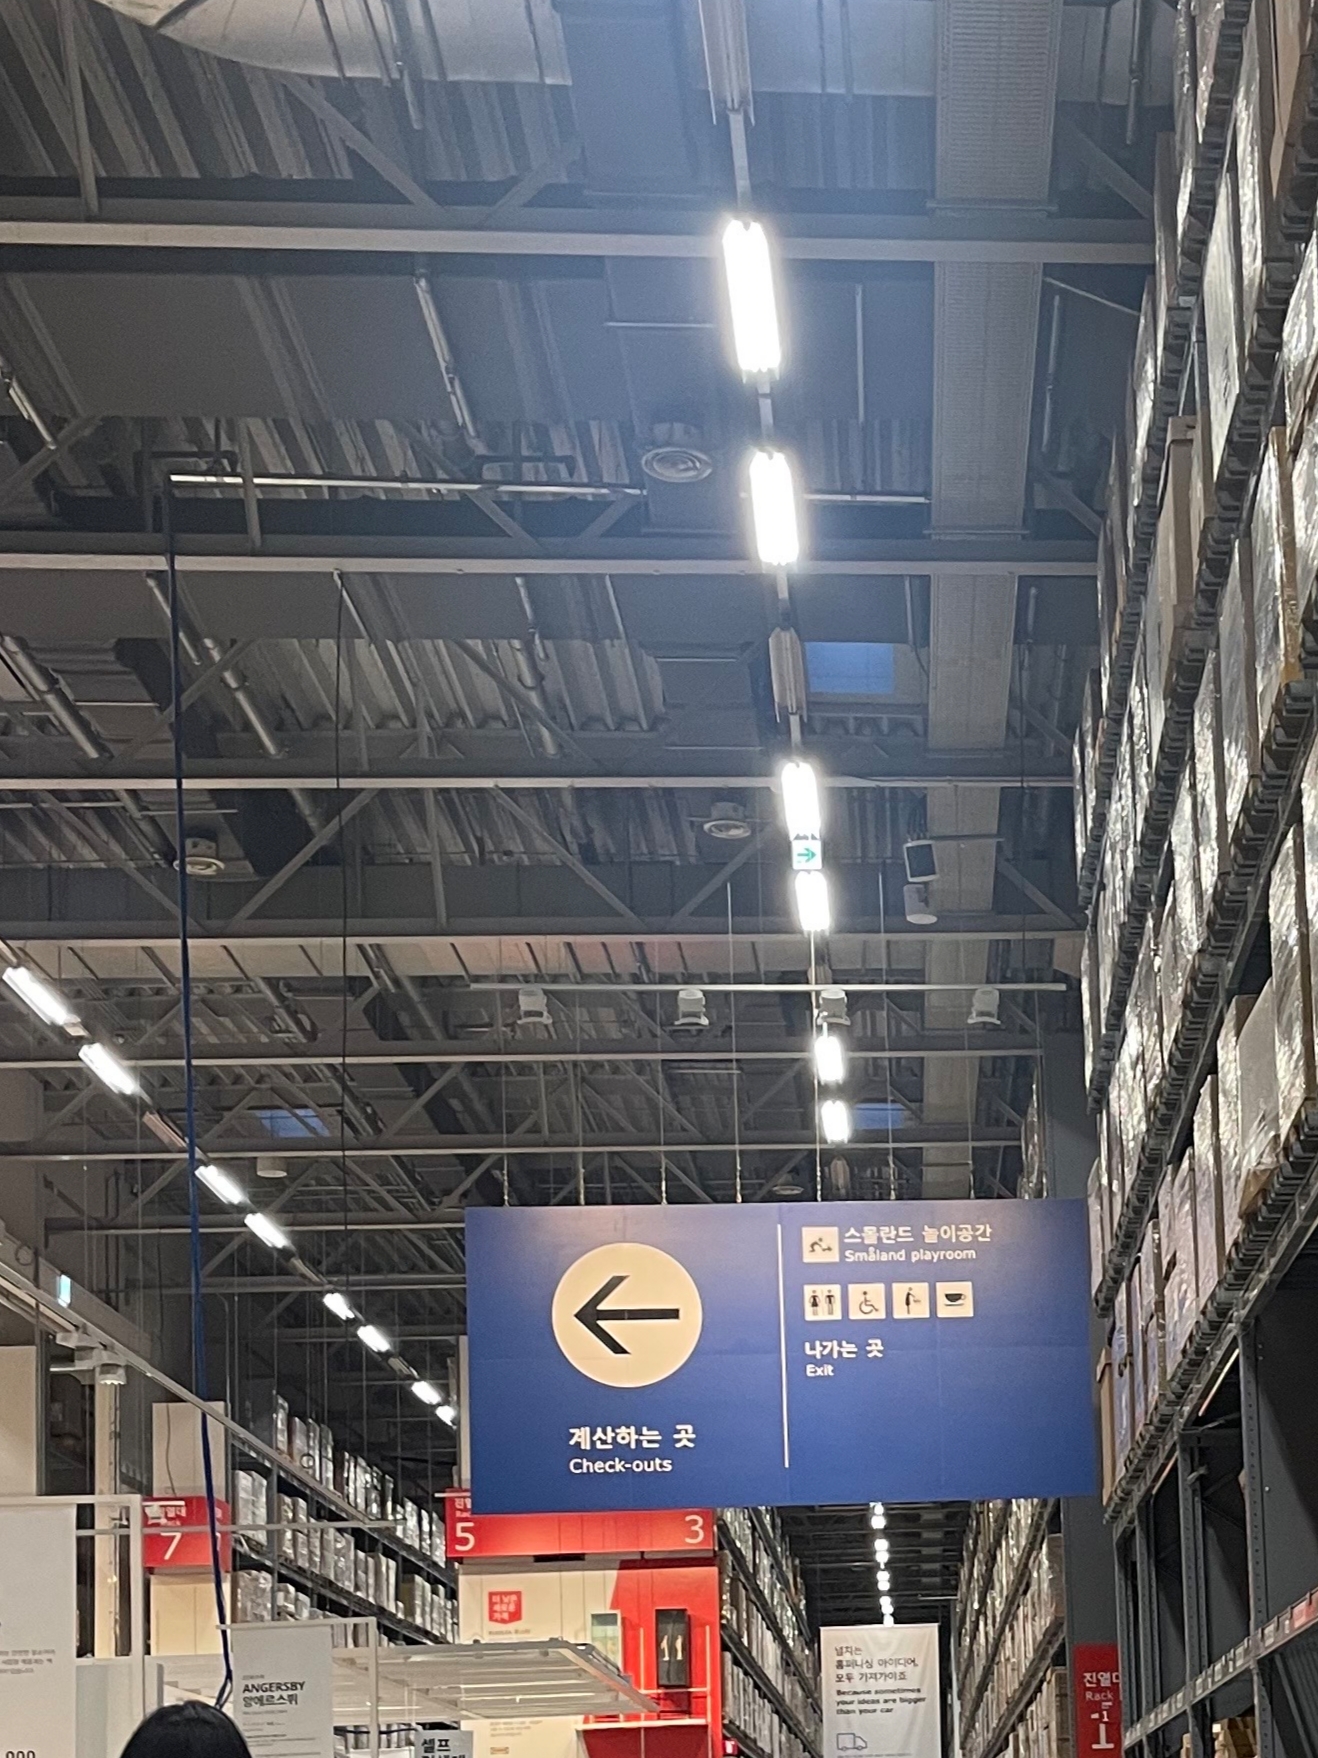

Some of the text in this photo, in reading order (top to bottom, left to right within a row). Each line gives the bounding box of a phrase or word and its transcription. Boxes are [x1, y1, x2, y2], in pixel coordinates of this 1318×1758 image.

[844, 1223, 992, 1245] 스몰란드 놀이공간
[844, 1246, 976, 1264] Småland playroom
[804, 1339, 884, 1360] 나가는 곳
[805, 1363, 835, 1378] Exit
[568, 1424, 697, 1451] 계산하는 곳
[569, 1456, 673, 1474] Check-outs
[454, 1522, 476, 1551] 5
[684, 1515, 705, 1544] 3
[160, 1532, 182, 1561] 7
[242, 1681, 305, 1694] ANGERSBY
[1085, 1690, 1114, 1701] Rack
[421, 1738, 452, 1753] 셀프
